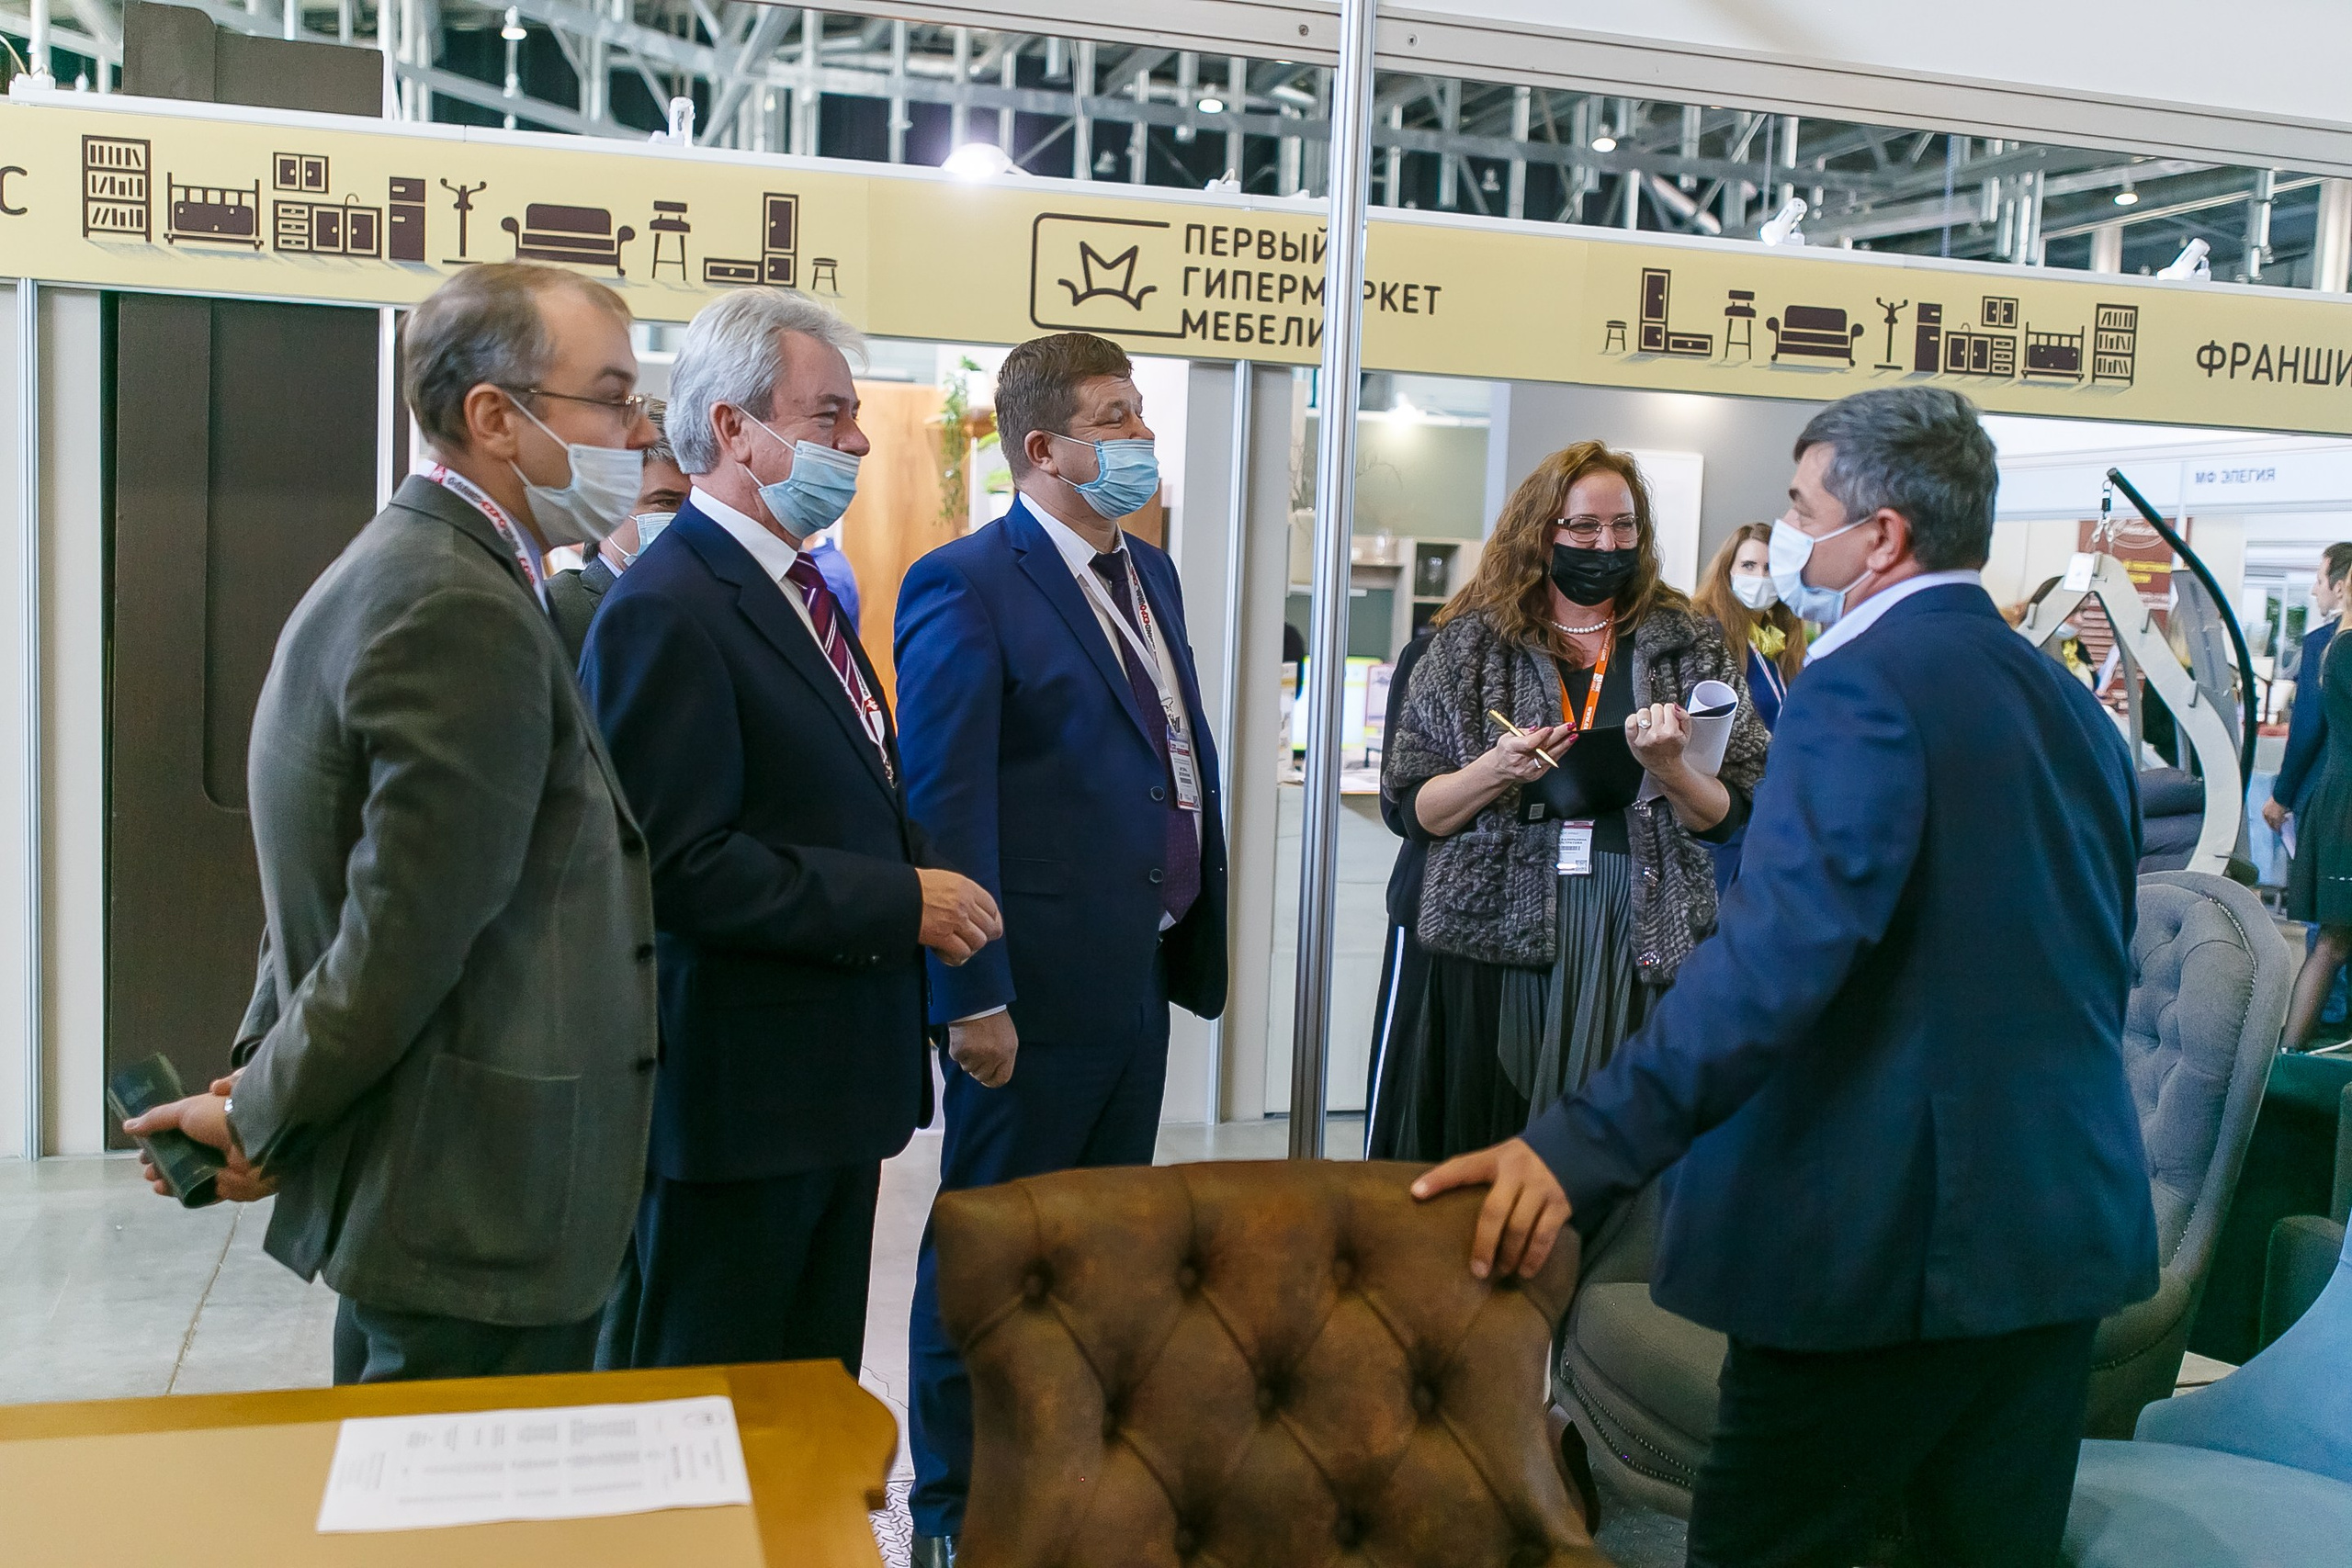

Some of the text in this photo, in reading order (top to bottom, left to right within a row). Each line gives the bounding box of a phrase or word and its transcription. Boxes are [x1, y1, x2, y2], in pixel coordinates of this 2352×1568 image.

[1185, 223, 1328, 264] ПЕРВЫЙ
[1183, 266, 1442, 315] ГИПЕРМРКЕТ
[1182, 309, 1324, 347] МЕБЕЛИ
[2197, 340, 2352, 388] ФРАНШИ
[2221, 468, 2276, 484] ЭЛЕГИЯ
